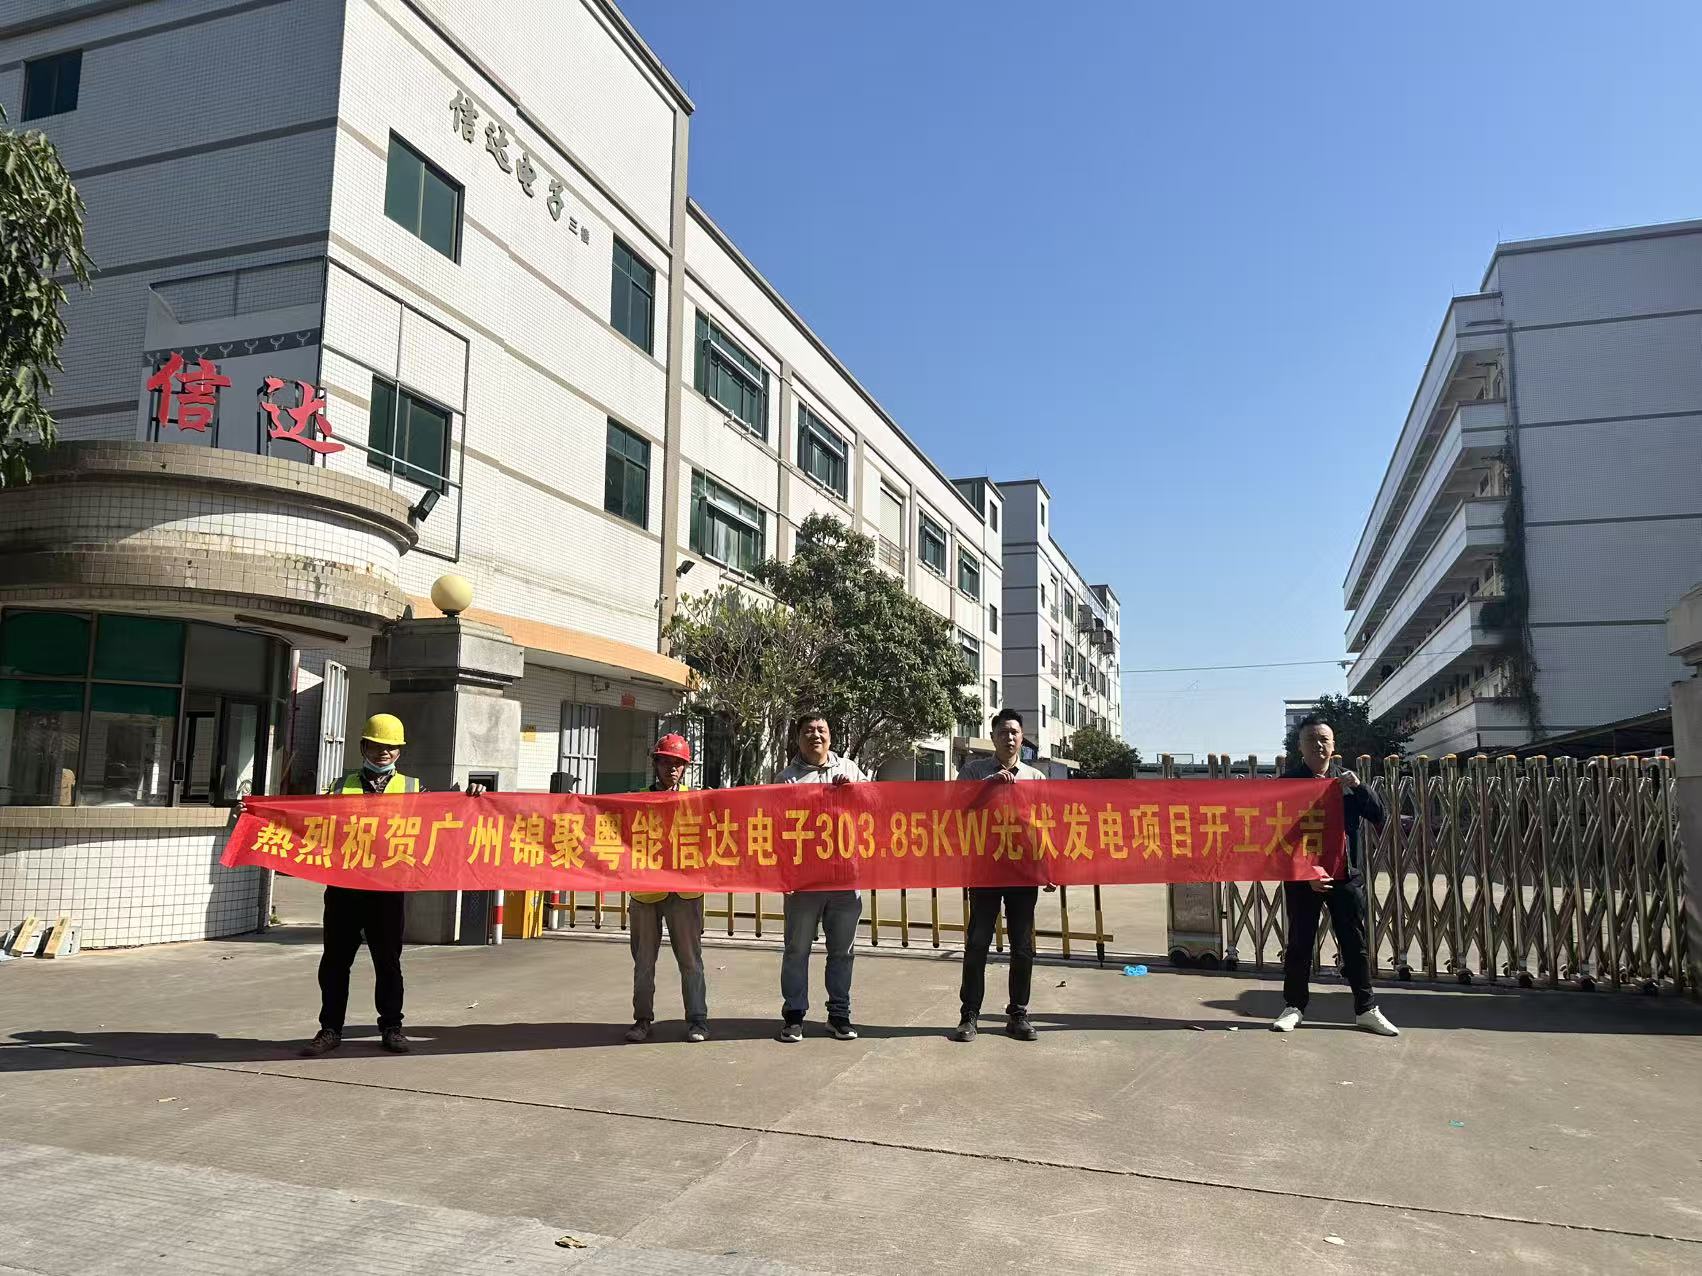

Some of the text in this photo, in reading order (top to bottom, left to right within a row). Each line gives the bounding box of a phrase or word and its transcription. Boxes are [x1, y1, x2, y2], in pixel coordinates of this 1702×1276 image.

[449, 89, 565, 222] 信达电子
[146, 351, 346, 454] 信达
[251, 801, 1326, 870] 热烈祝贺广州锦聚粤能信达电子303.85KW光伏发电项目开工大吉
